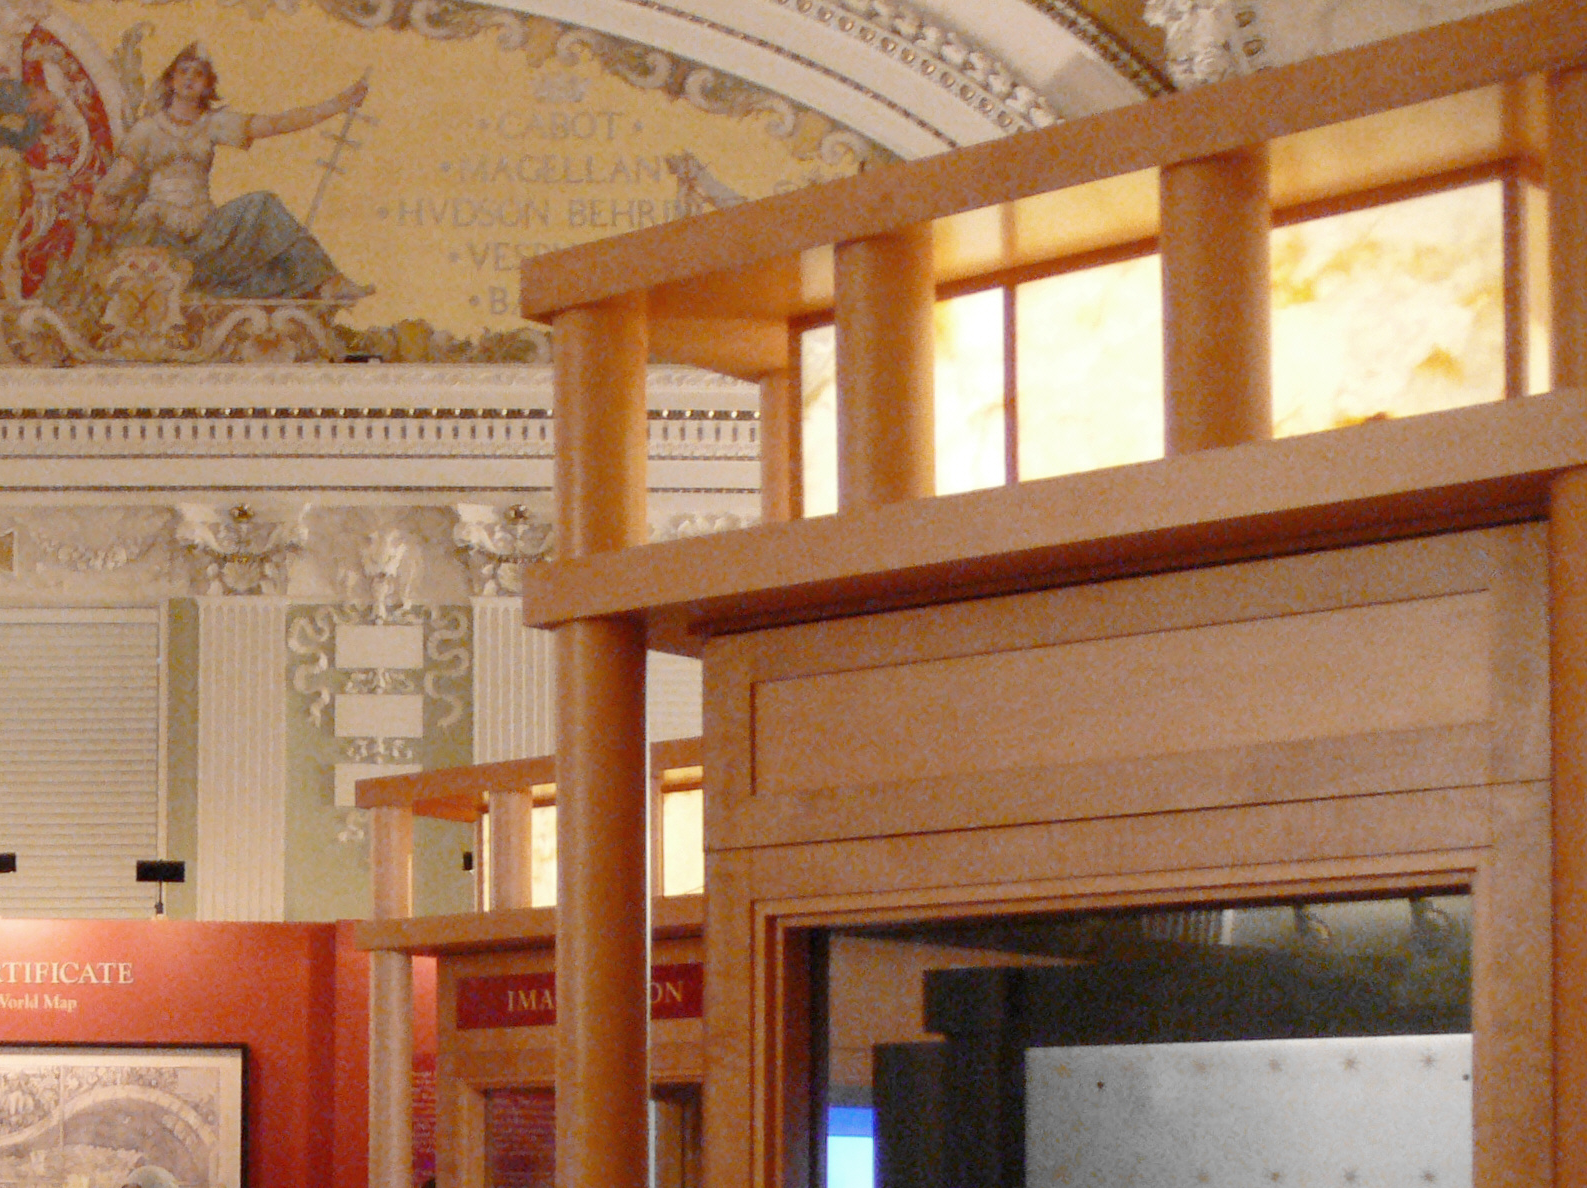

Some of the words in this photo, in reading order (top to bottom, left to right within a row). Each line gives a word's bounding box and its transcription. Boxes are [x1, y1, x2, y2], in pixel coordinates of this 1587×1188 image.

[496, 111, 625, 140] CABOT
[396, 198, 550, 228] HVDSON
[43, 993, 78, 1012] Map
